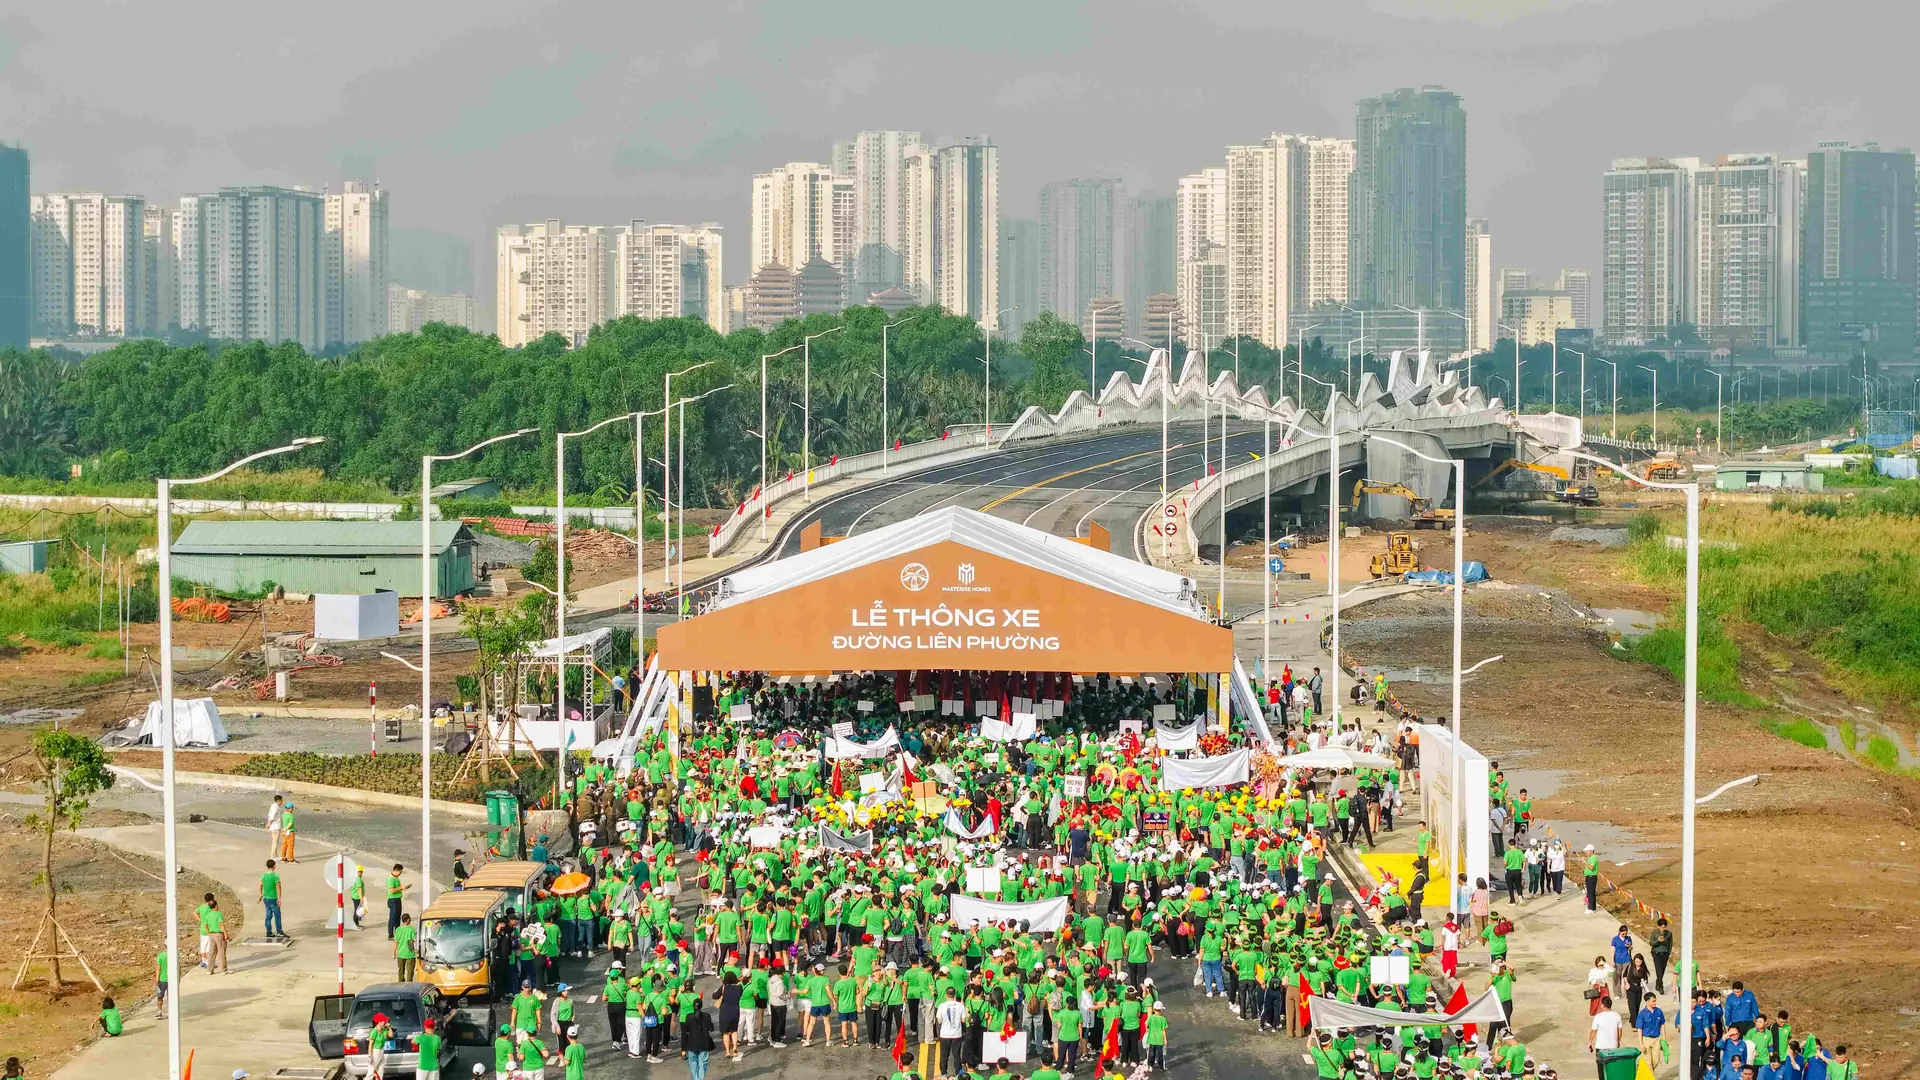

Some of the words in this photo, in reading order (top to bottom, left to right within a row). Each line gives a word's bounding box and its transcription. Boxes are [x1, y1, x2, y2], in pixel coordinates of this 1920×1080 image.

[851, 599, 888, 627] LỄ
[892, 602, 996, 628] THÔNG
[1001, 608, 1041, 628] XE
[831, 631, 913, 650] ĐƯỜNG
[916, 631, 962, 650] LIÊN
[966, 632, 1060, 651] PHƯỜNG
